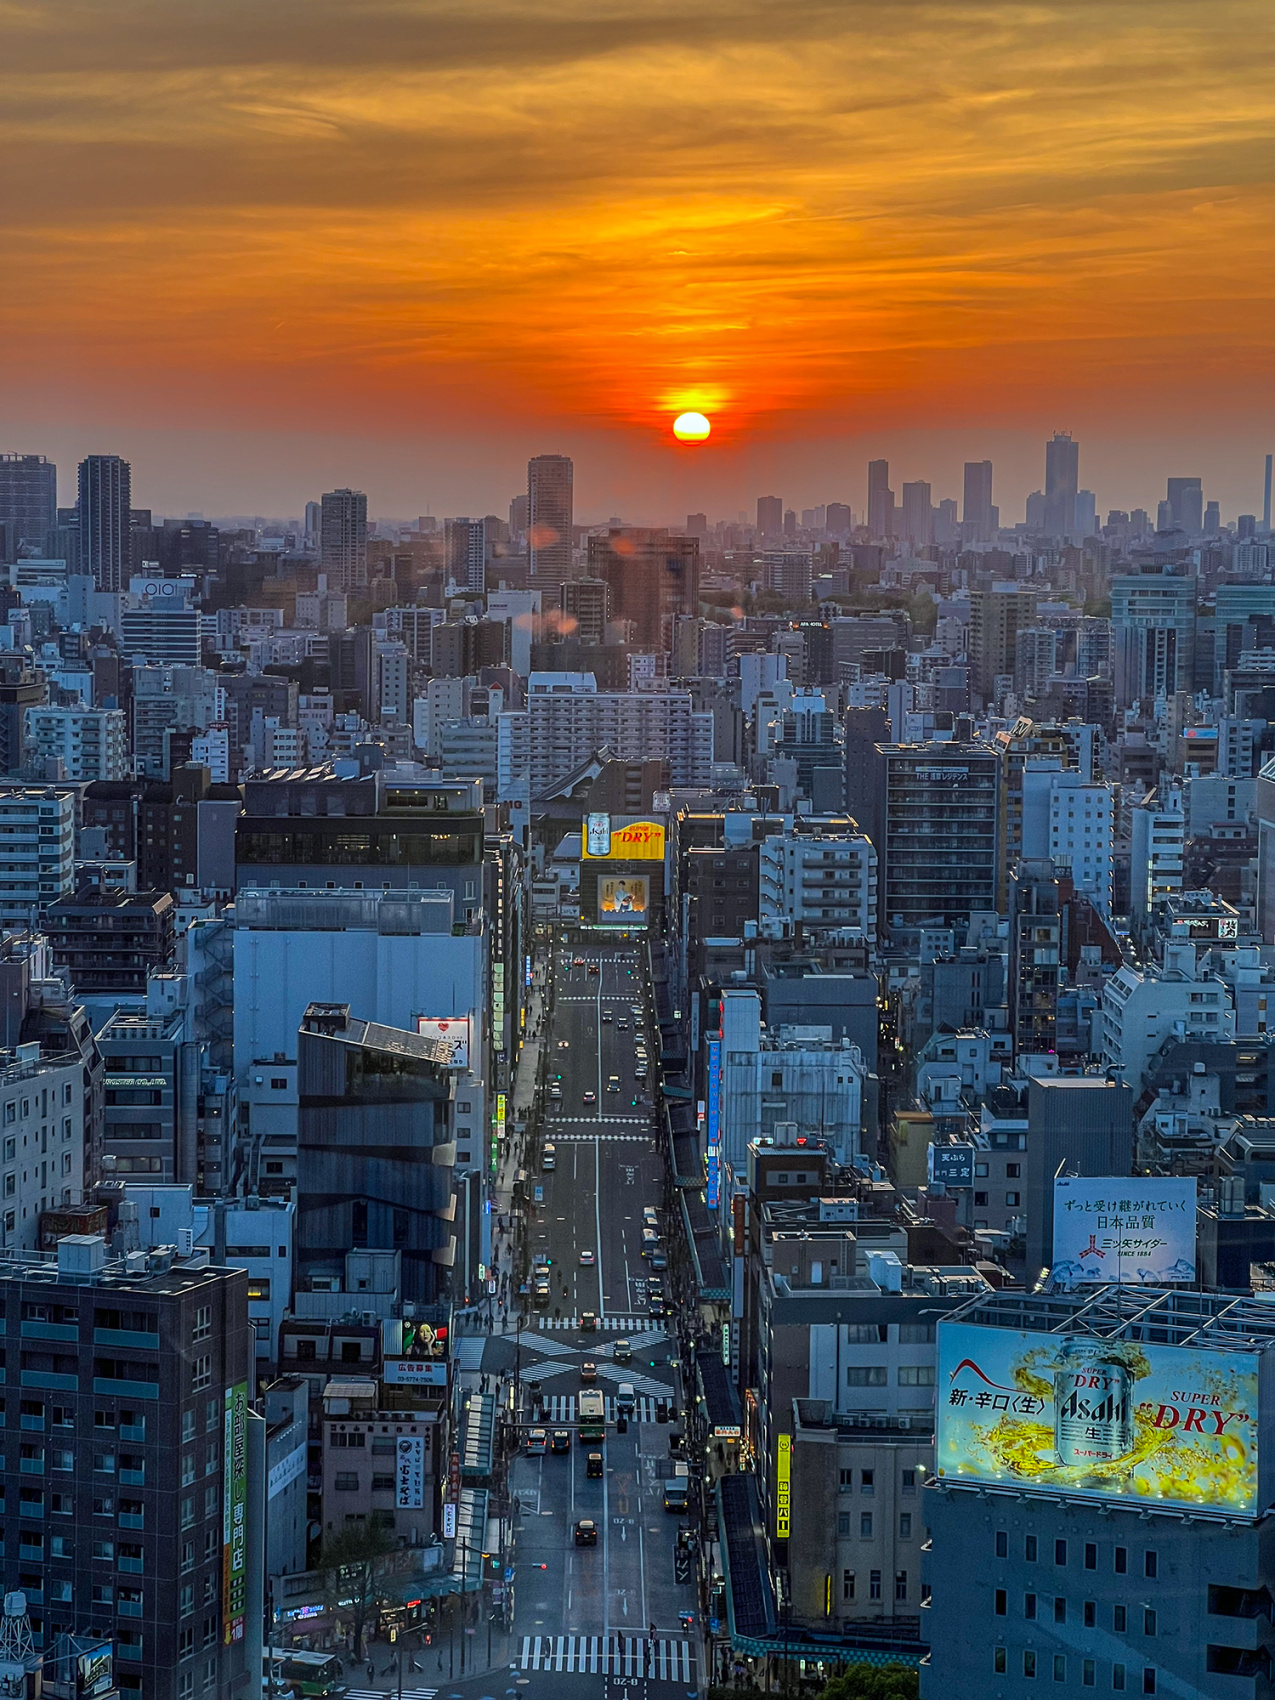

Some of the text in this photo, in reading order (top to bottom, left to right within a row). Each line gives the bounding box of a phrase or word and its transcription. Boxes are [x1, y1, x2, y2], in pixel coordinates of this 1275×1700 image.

[941, 1153, 966, 1162] 天ぷら
[1064, 1199, 1187, 1213] ずっと受け継がれていく
[1097, 1214, 1156, 1230] 日本品質
[1101, 1238, 1169, 1249] 三ツ矢サイダー
[398, 1363, 432, 1373] 広告募集
[1081, 1367, 1107, 1376] SUPER
[1170, 1390, 1220, 1407] SUPER
[1060, 1389, 1128, 1426] Asahi
[1085, 1427, 1102, 1441] 生
[1073, 1448, 1114, 1459] スーパードライ
[233, 1391, 245, 1571] お部屋探し専門店
[779, 1482, 788, 1530] 神谷バー
[613, 1677, 638, 1686] 8-20
